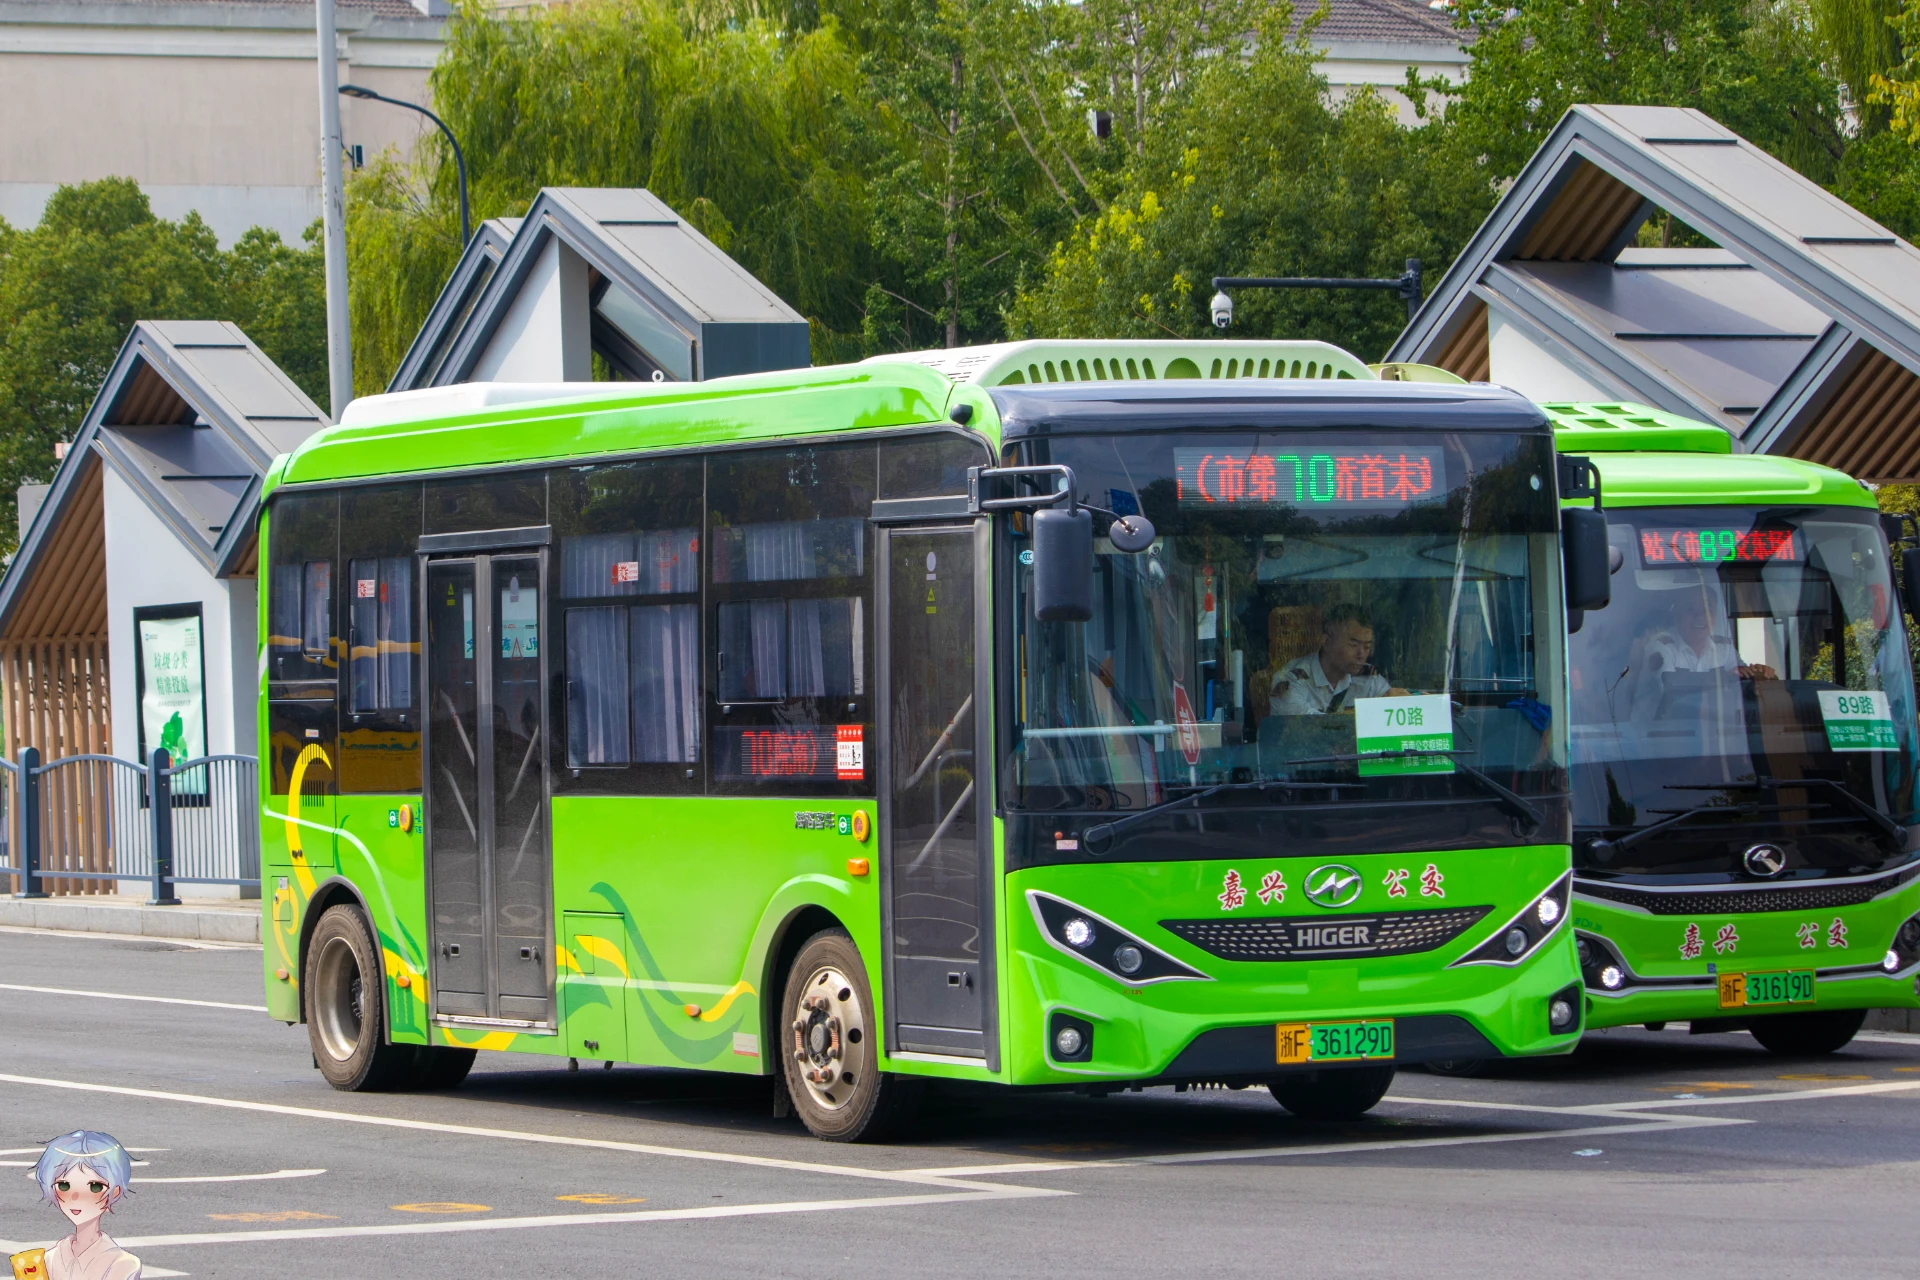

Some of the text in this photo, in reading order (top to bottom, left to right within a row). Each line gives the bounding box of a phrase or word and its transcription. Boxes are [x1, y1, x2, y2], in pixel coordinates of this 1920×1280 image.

[1384, 706, 1424, 727] 70路
[1838, 696, 1875, 715] 89路
[1218, 864, 1446, 910] 嘉兴 公交
[1297, 926, 1370, 947] HIGER
[1679, 917, 1848, 960] 嘉兴 公交
[1750, 975, 1812, 1001] 31619D
[1316, 1026, 1392, 1056] 36129D
